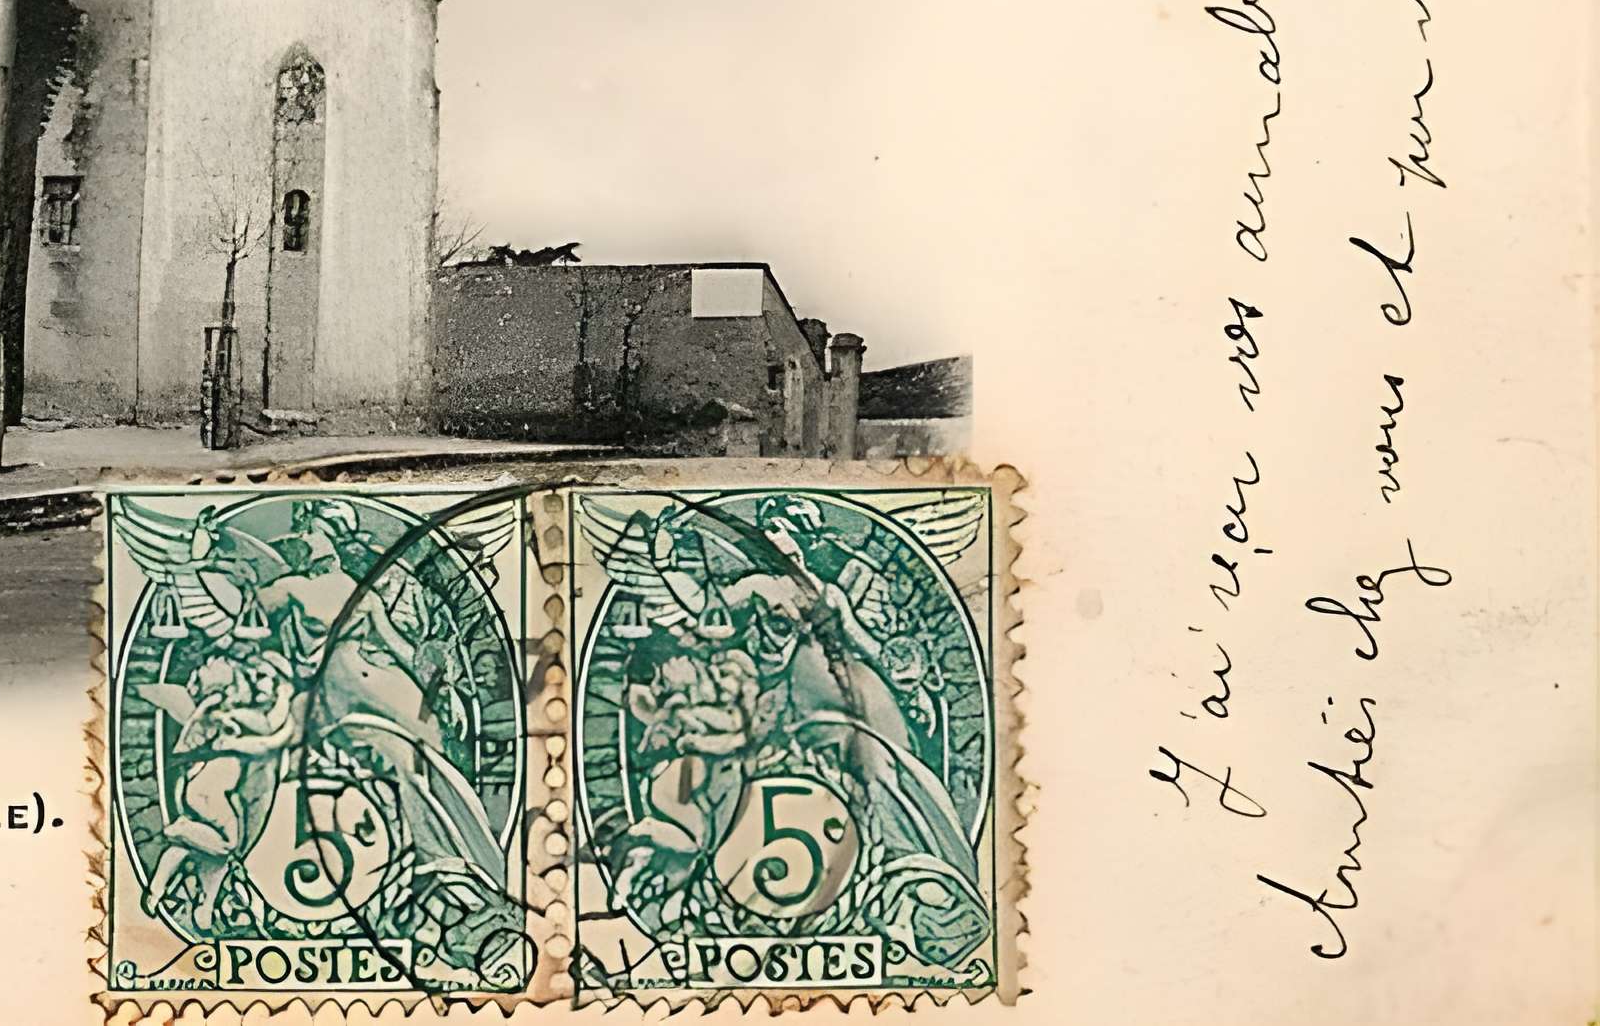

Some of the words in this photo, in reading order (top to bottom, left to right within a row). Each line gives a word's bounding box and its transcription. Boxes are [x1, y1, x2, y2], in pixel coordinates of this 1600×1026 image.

[1349, 212, 1414, 326] et
[1224, 297, 1263, 411] vos
[1378, 374, 1404, 503] vous
[1305, 539, 1452, 660] chez
[225, 947, 408, 984] POSTES
[693, 945, 880, 981] POSTES
